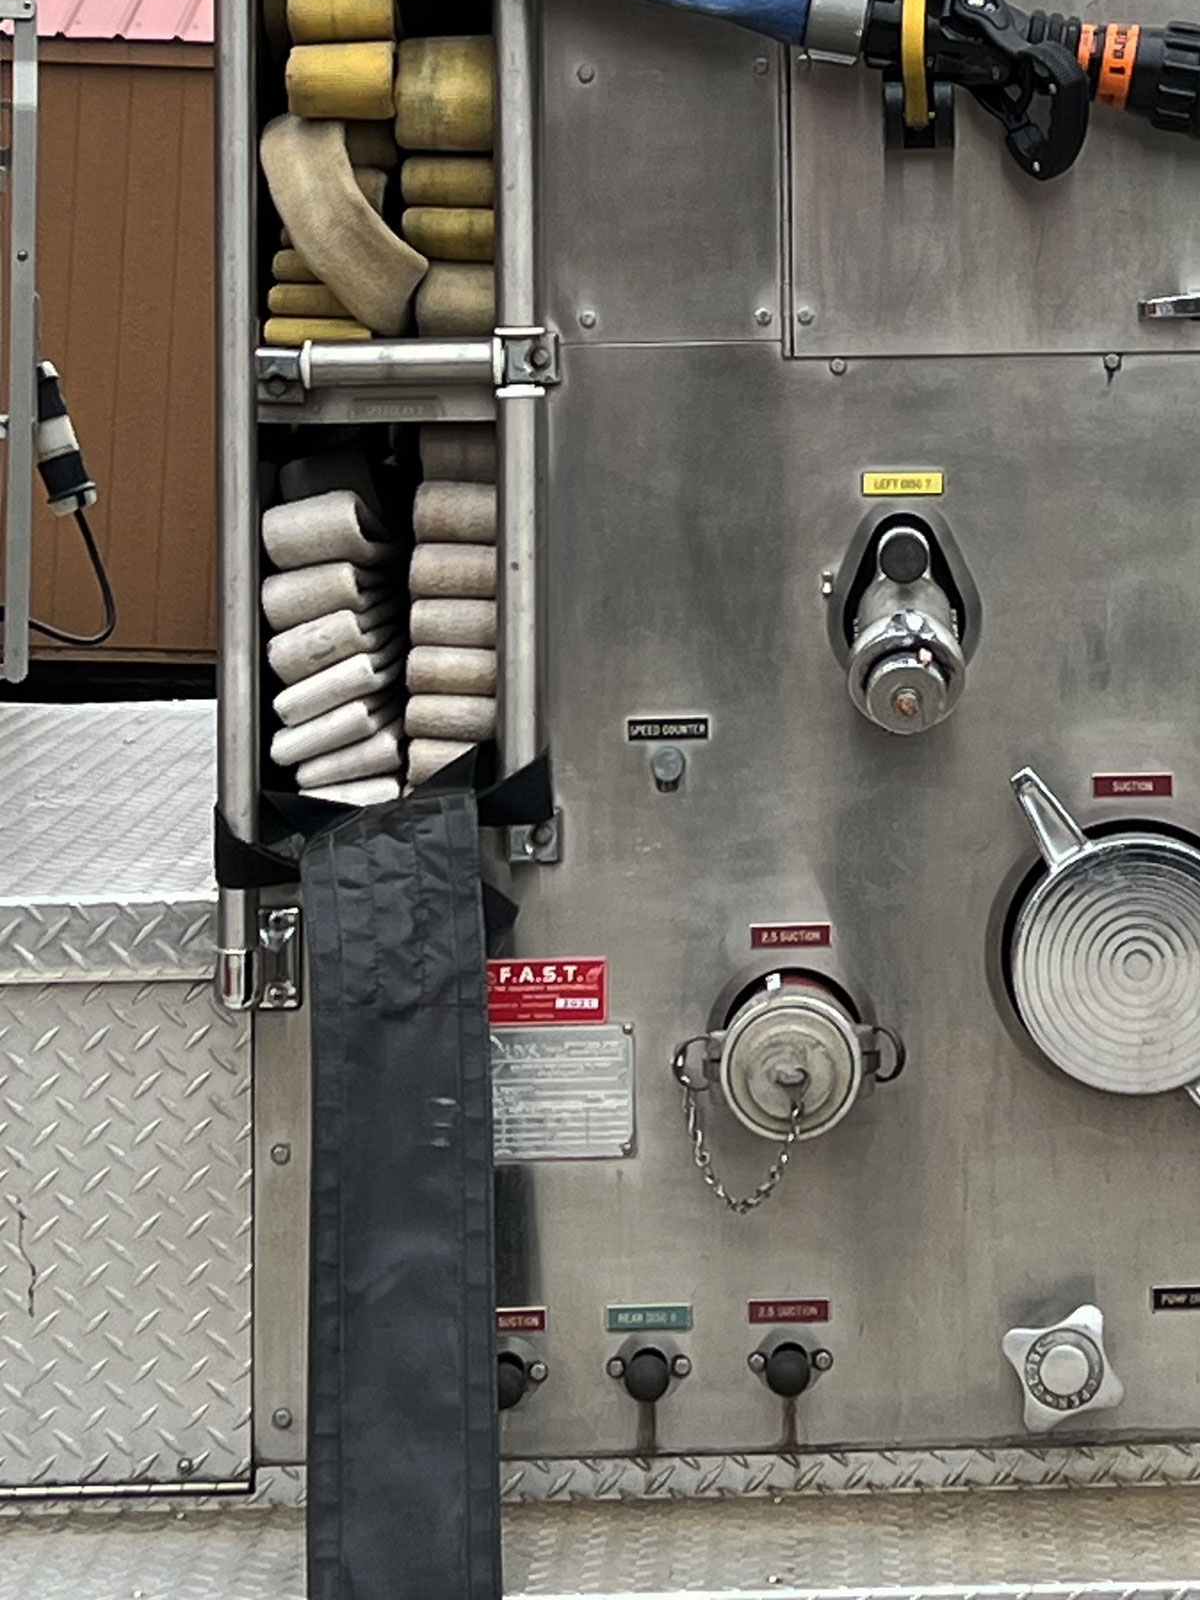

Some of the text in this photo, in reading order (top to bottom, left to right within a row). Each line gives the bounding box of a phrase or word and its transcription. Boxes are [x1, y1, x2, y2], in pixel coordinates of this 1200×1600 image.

[873, 478, 899, 490] LEFT
[630, 723, 706, 736] SPEED COUNTER
[1112, 780, 1154, 793] SUCTION
[761, 930, 821, 943] 2.5 SUCTION
[1160, 1293, 1188, 1305] PUMP
[617, 1312, 643, 1323] REAR
[758, 1305, 818, 1318] 2.5 SUCTION
[498, 1315, 540, 1327] SUCTION
